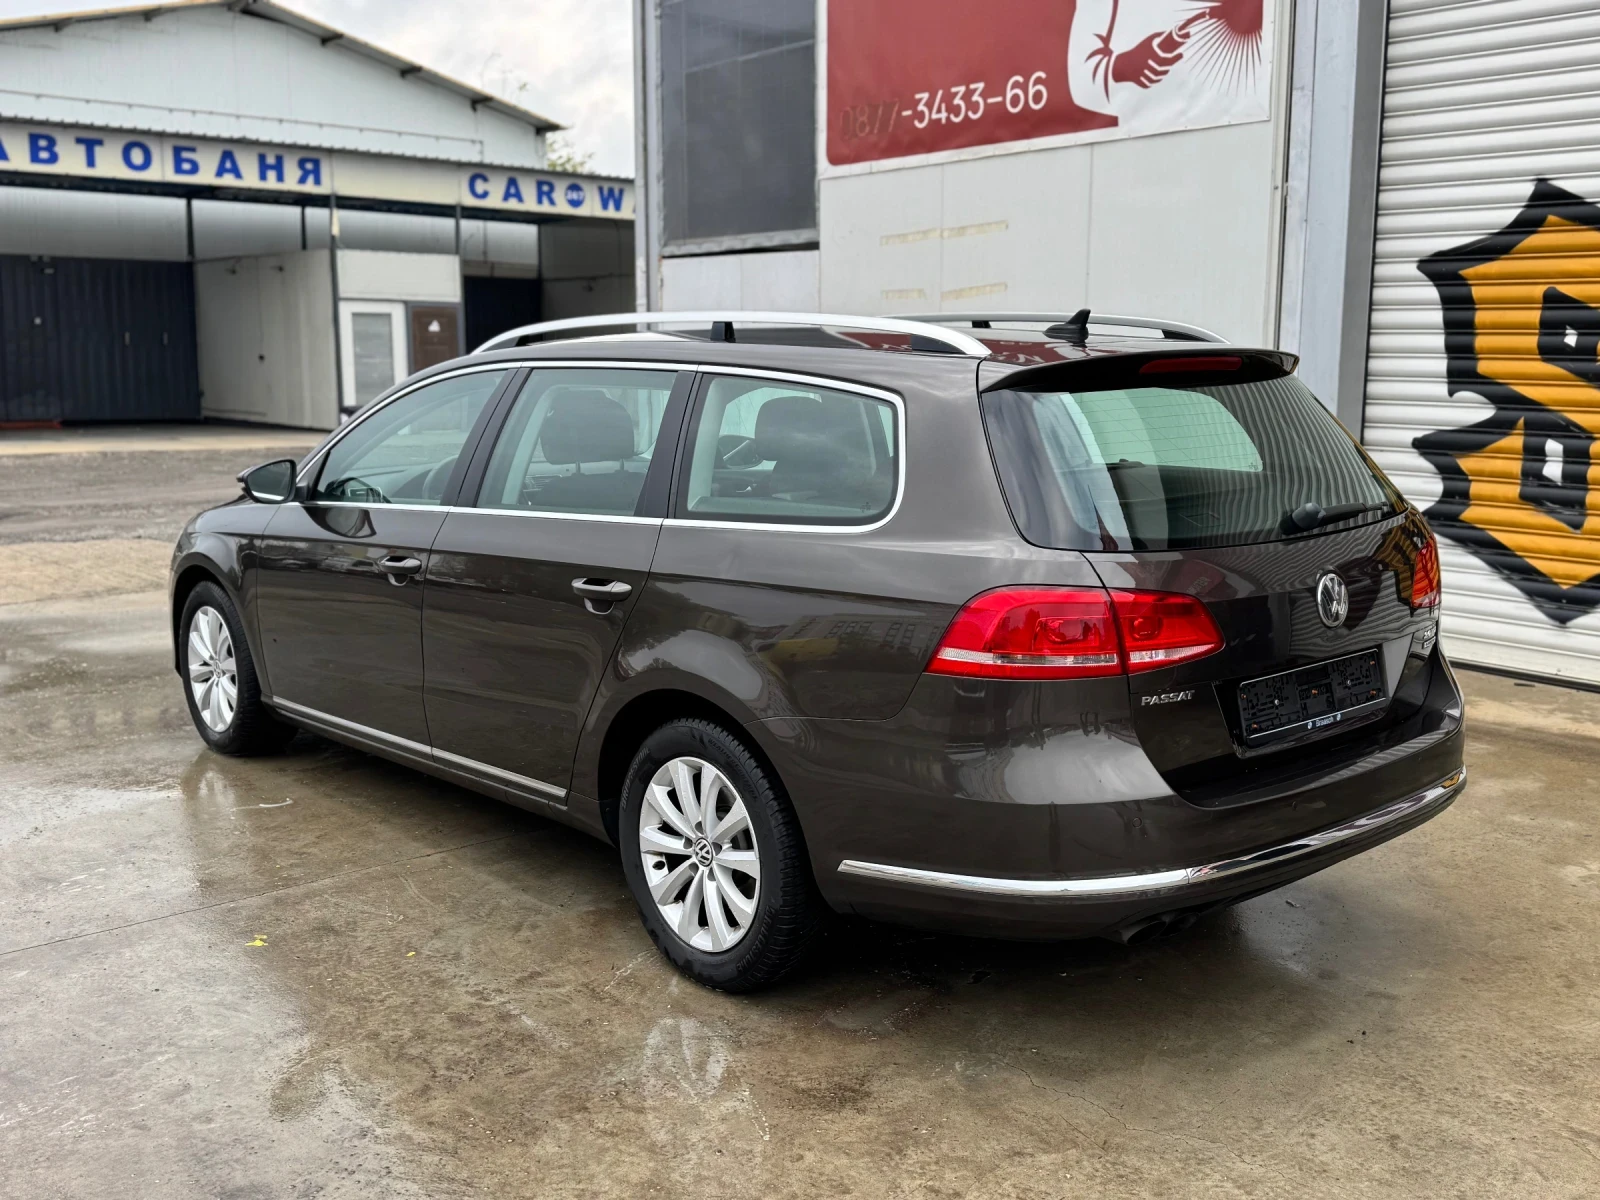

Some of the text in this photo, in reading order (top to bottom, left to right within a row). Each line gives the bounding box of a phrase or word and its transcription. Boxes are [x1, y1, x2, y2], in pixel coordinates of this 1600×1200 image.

[468, 172, 557, 207] CAR
[598, 185, 635, 213] W
[1141, 690, 1195, 706] PASSAT
